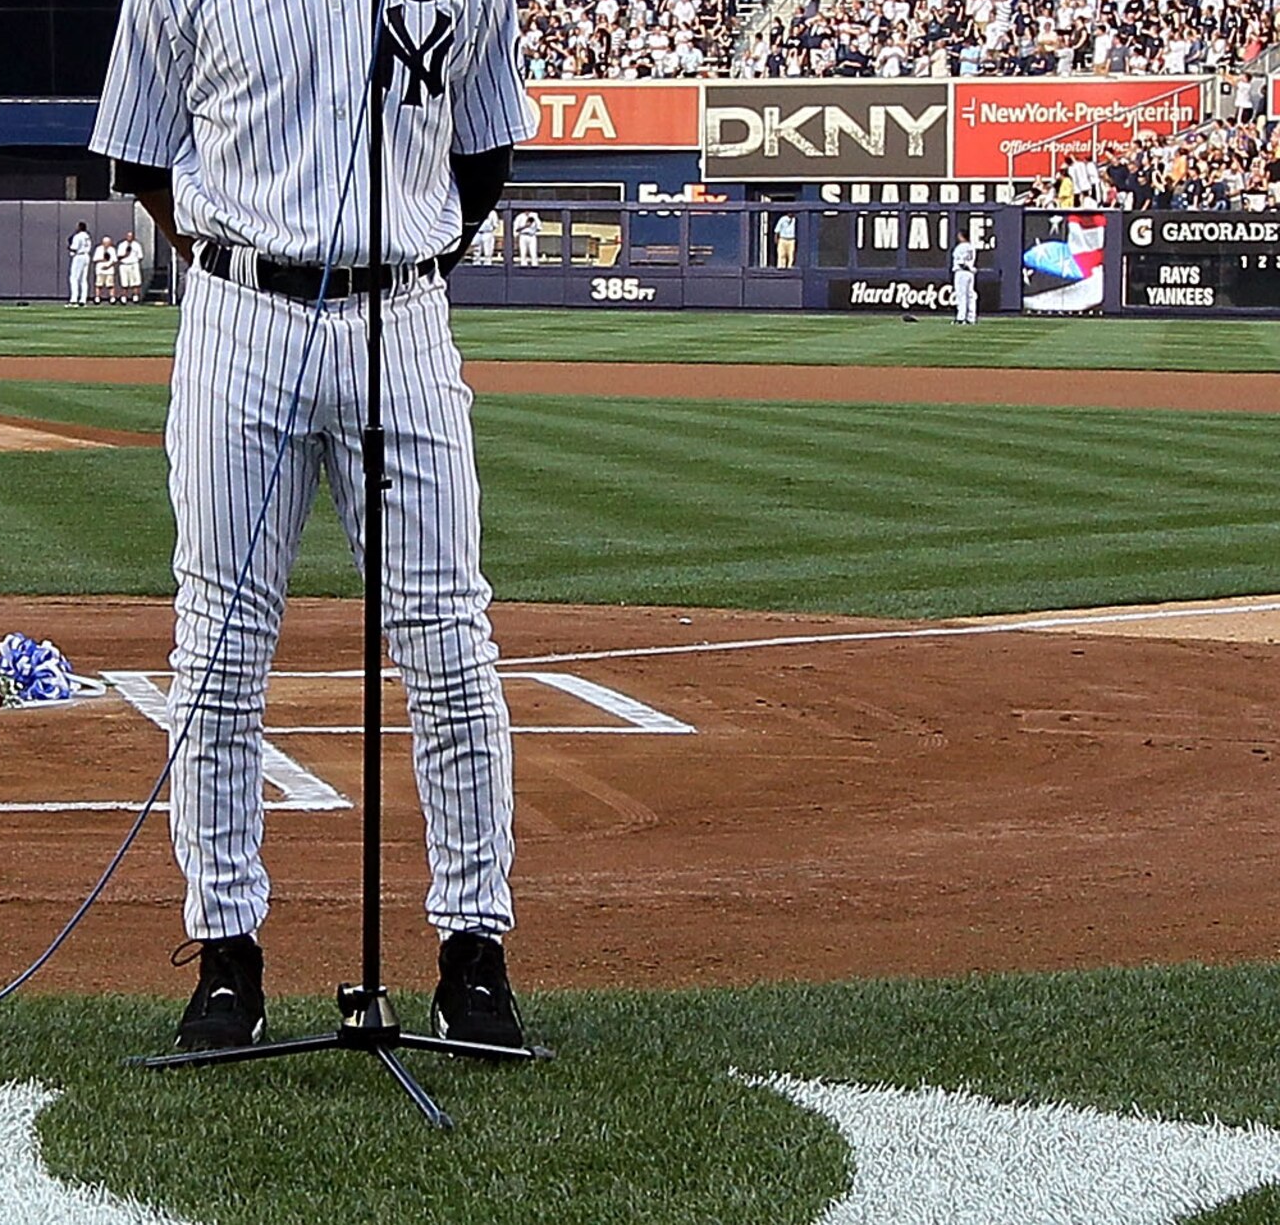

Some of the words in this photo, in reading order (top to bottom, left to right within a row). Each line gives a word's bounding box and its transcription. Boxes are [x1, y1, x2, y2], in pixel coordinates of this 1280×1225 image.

[707, 104, 947, 158] DKNY
[1162, 222, 1279, 242] GATORADE
[1258, 255, 1267, 269] 2
[1159, 265, 1200, 285] RAYS
[851, 282, 892, 305] Hard
[895, 283, 938, 309] Rock
[1146, 286, 1215, 306] YANKEES
